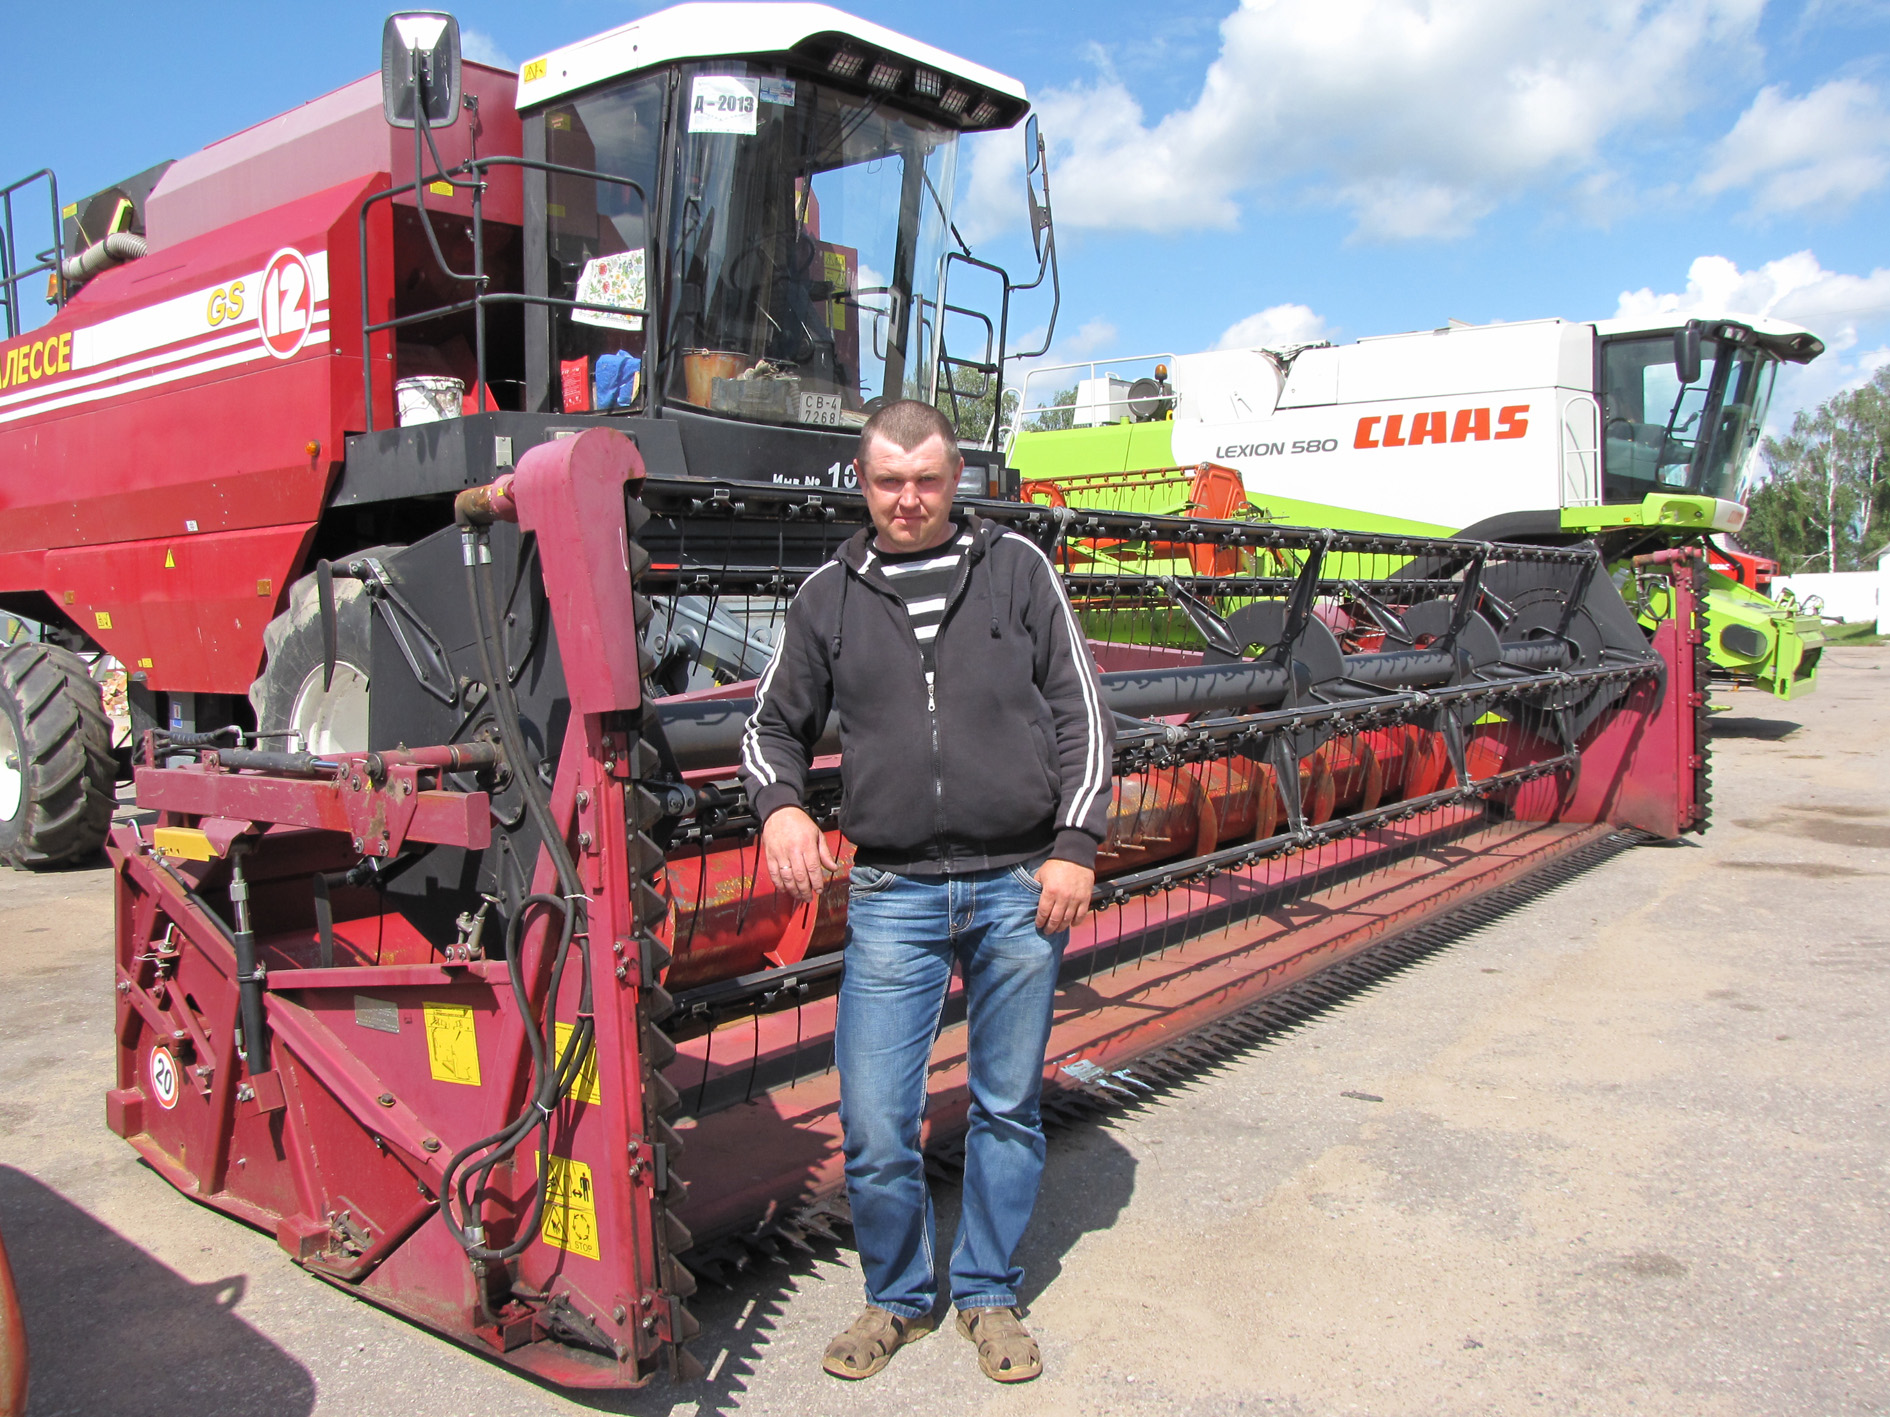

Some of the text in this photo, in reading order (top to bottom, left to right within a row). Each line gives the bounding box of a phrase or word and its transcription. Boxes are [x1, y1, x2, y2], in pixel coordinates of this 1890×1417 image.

[206, 262, 307, 338] GS 12
[804, 410, 836, 424] 7268
[1353, 404, 1530, 449] CLAAS
[1216, 438, 1338, 459] LEXION 580
[155, 1057, 172, 1095] 20
[574, 1240, 593, 1253] STOP
